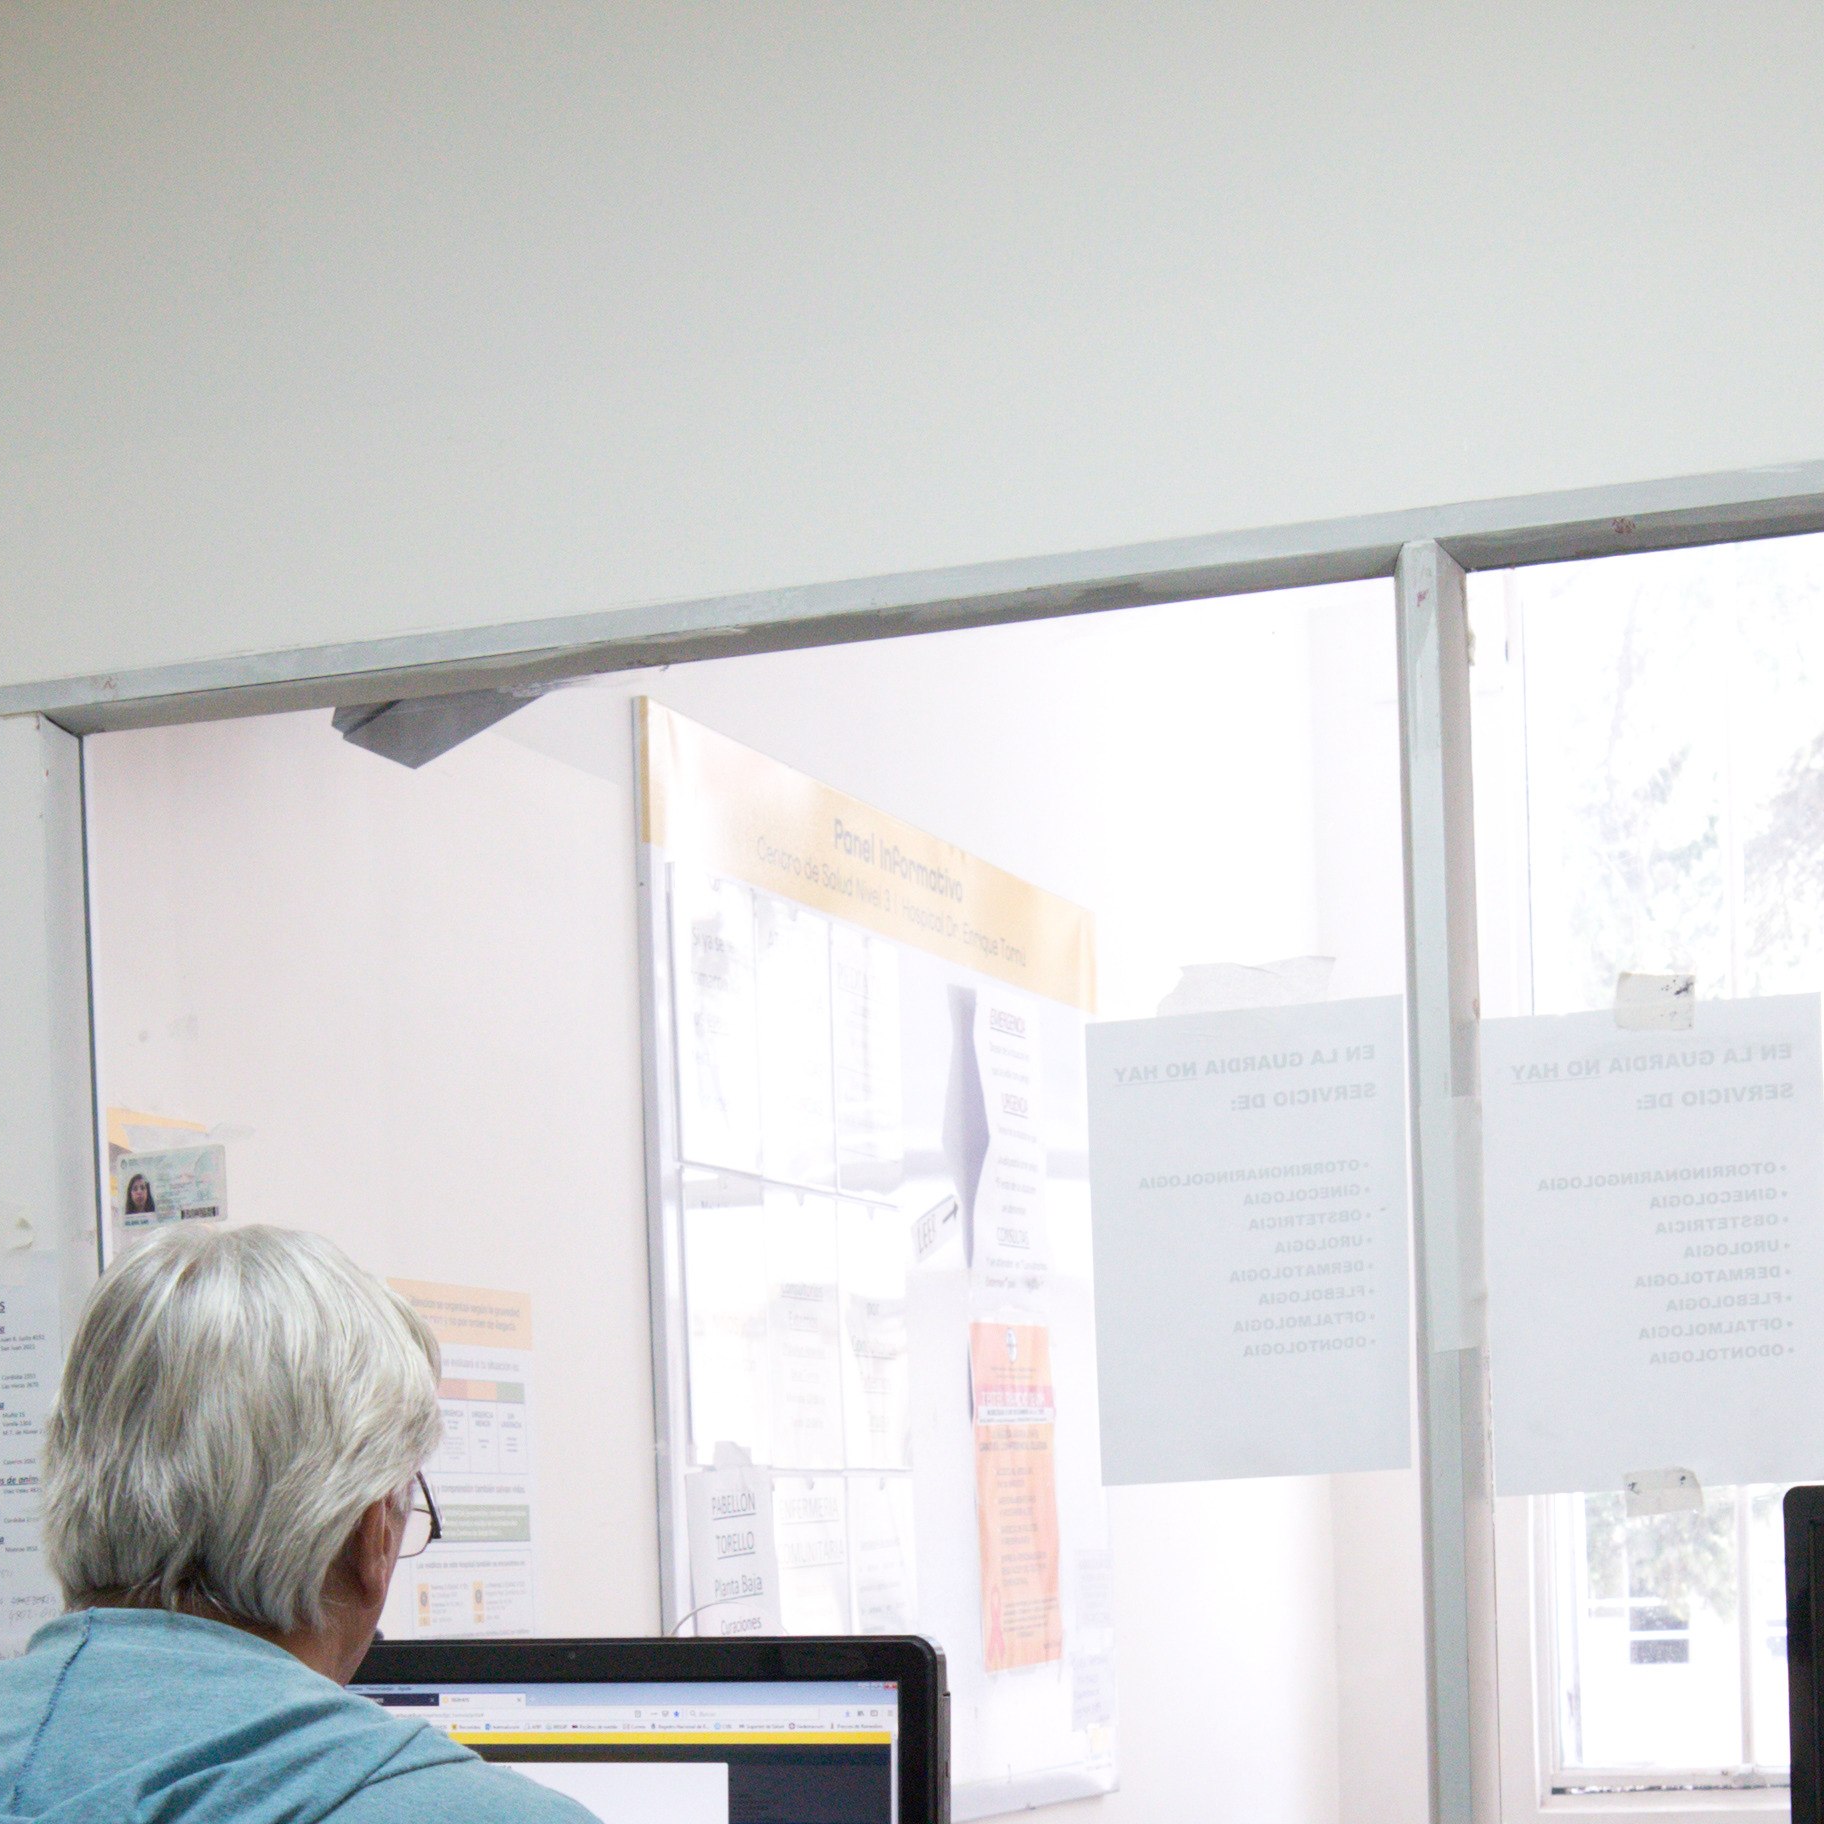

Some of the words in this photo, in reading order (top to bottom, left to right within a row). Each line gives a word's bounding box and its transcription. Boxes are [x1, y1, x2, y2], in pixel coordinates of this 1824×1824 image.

[833, 817, 875, 865] Panel
[878, 837, 964, 903] Informativo
[822, 863, 853, 897] Salud
[7, 1476, 16, 1485] de
[712, 1491, 757, 1516] PABELLON
[716, 1530, 755, 1555] TORELLO
[714, 1576, 740, 1599] Planta
[741, 1572, 763, 1597] Baja
